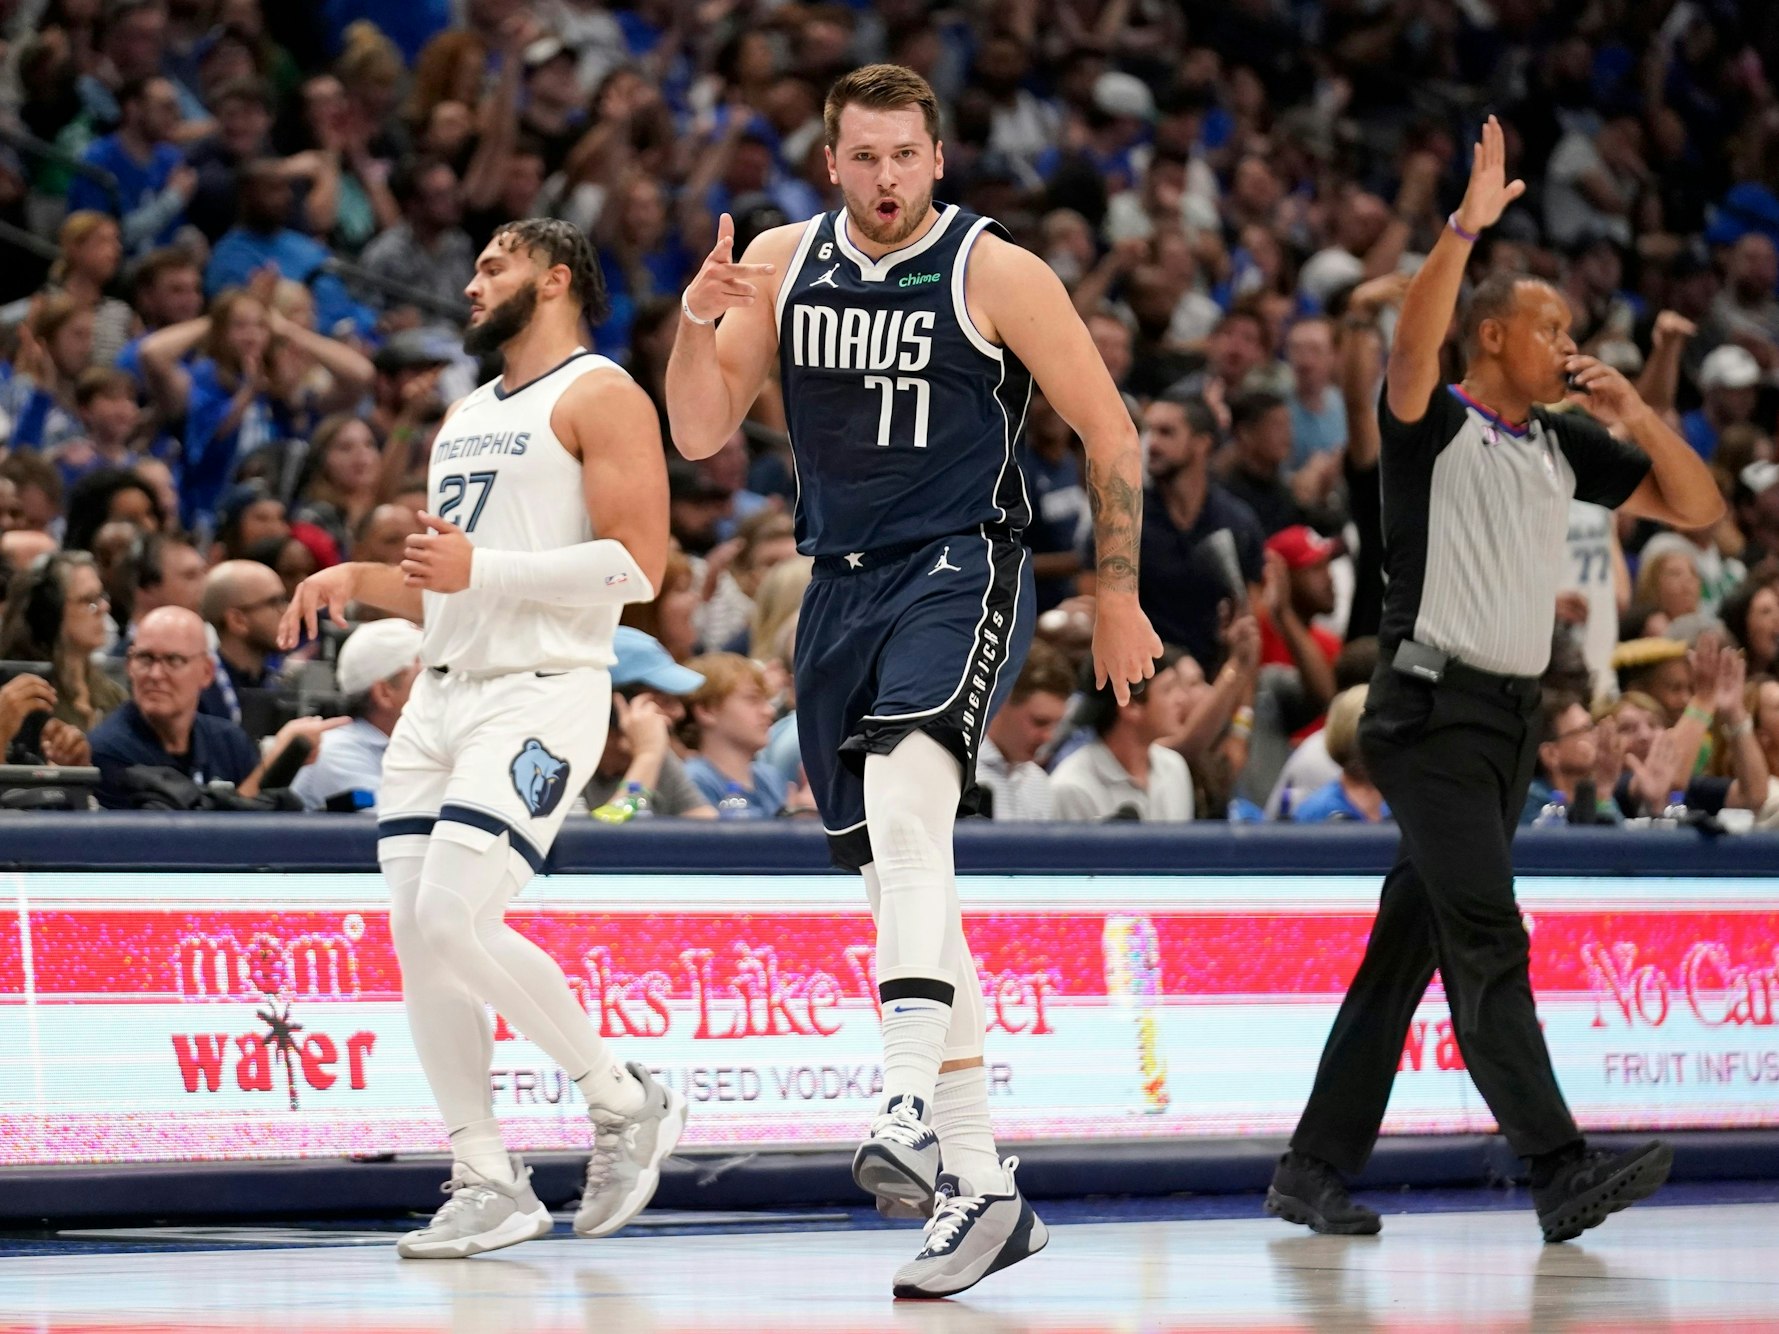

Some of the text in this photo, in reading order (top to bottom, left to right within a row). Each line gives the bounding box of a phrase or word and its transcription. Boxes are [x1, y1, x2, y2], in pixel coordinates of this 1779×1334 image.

[817, 242, 834, 260] 6
[899, 272, 941, 288] chime
[864, 375, 930, 448] 77
[433, 432, 532, 464] MEMPHIS
[439, 470, 498, 532] 27
[679, 941, 844, 1039] Like
[1579, 940, 1672, 1029] No
[1605, 1052, 1686, 1084] FRUIT
